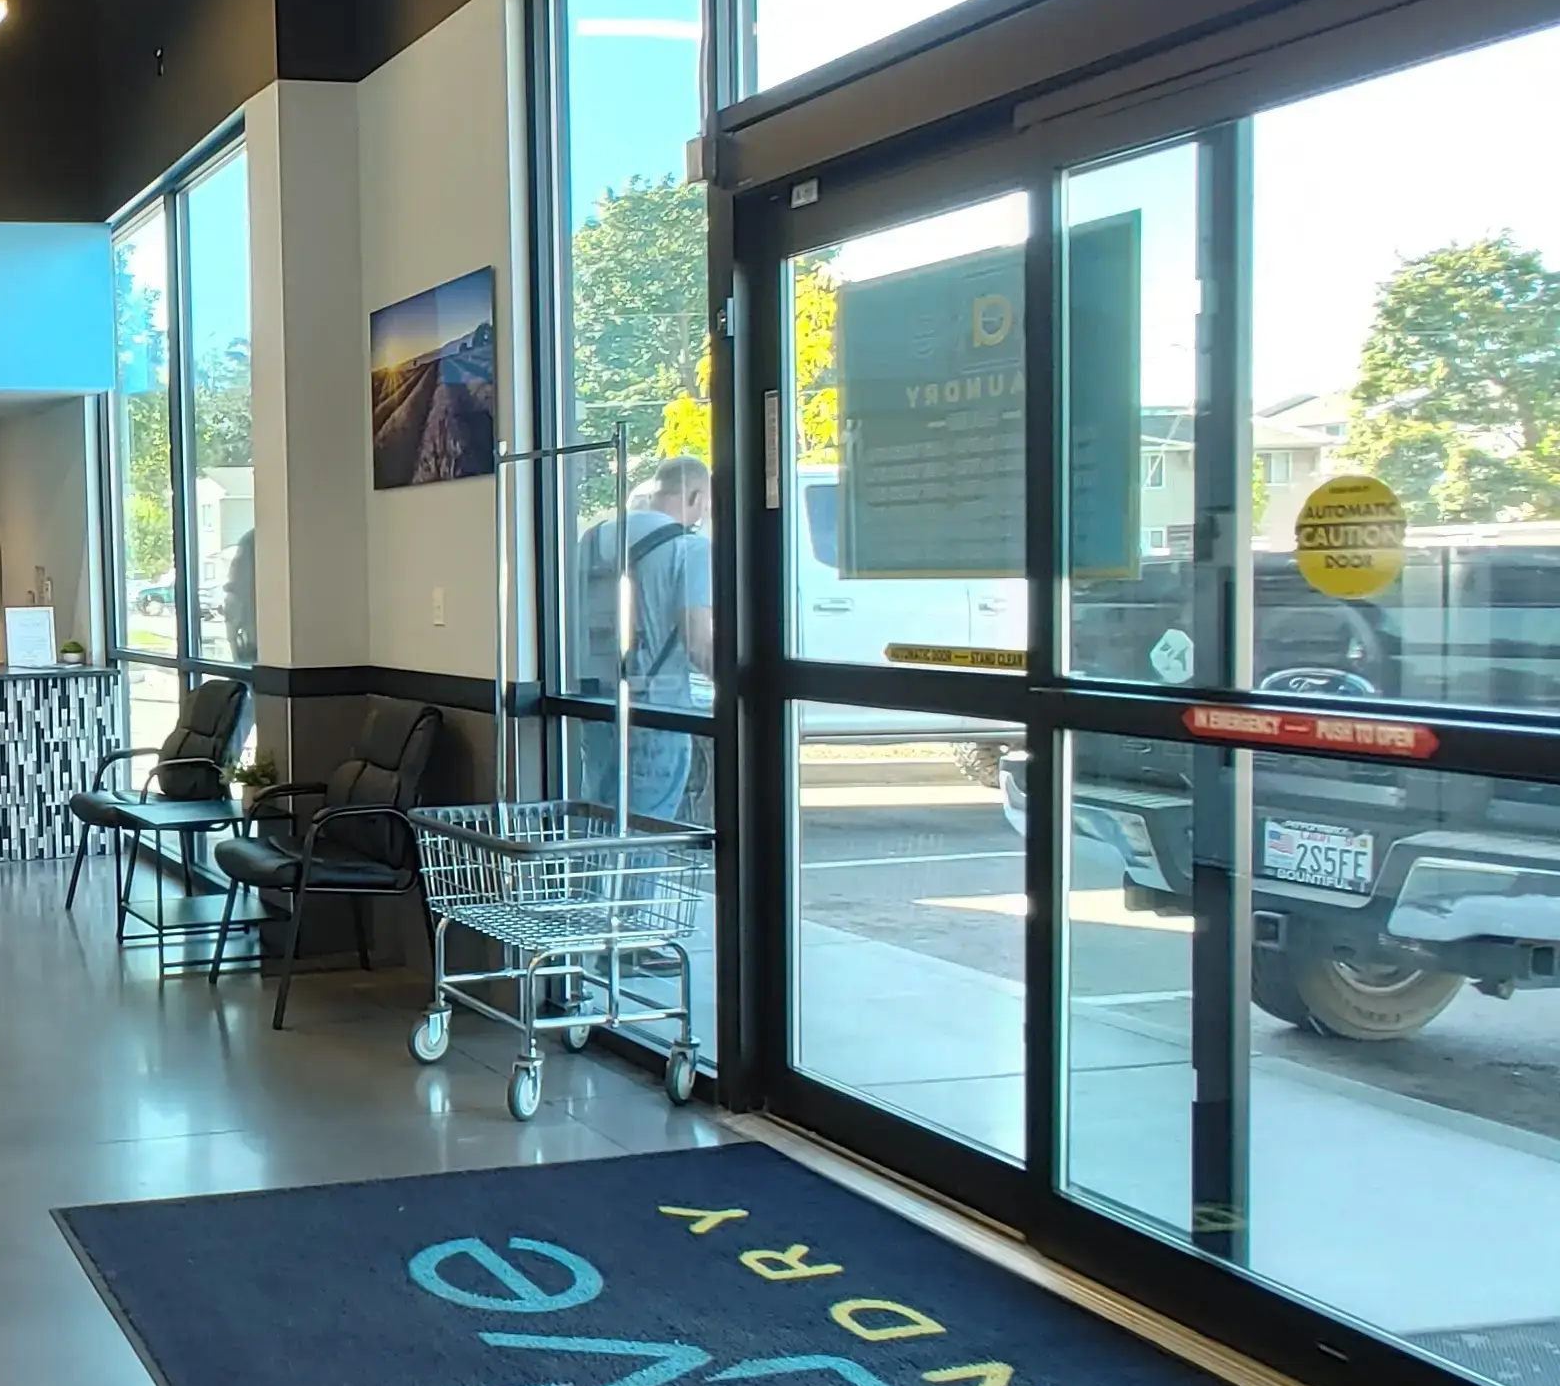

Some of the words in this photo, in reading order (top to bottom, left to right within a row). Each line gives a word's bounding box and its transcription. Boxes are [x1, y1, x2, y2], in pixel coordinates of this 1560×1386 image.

[1305, 502, 1397, 520] AUTOMATIC
[1300, 525, 1403, 548] CAUTION
[1324, 554, 1373, 569] DOOR
[971, 651, 995, 665] STAND
[997, 653, 1023, 667] CLEAR
[1316, 719, 1354, 742] PUSH
[1355, 724, 1374, 745] TO
[1375, 725, 1416, 749] OPEN
